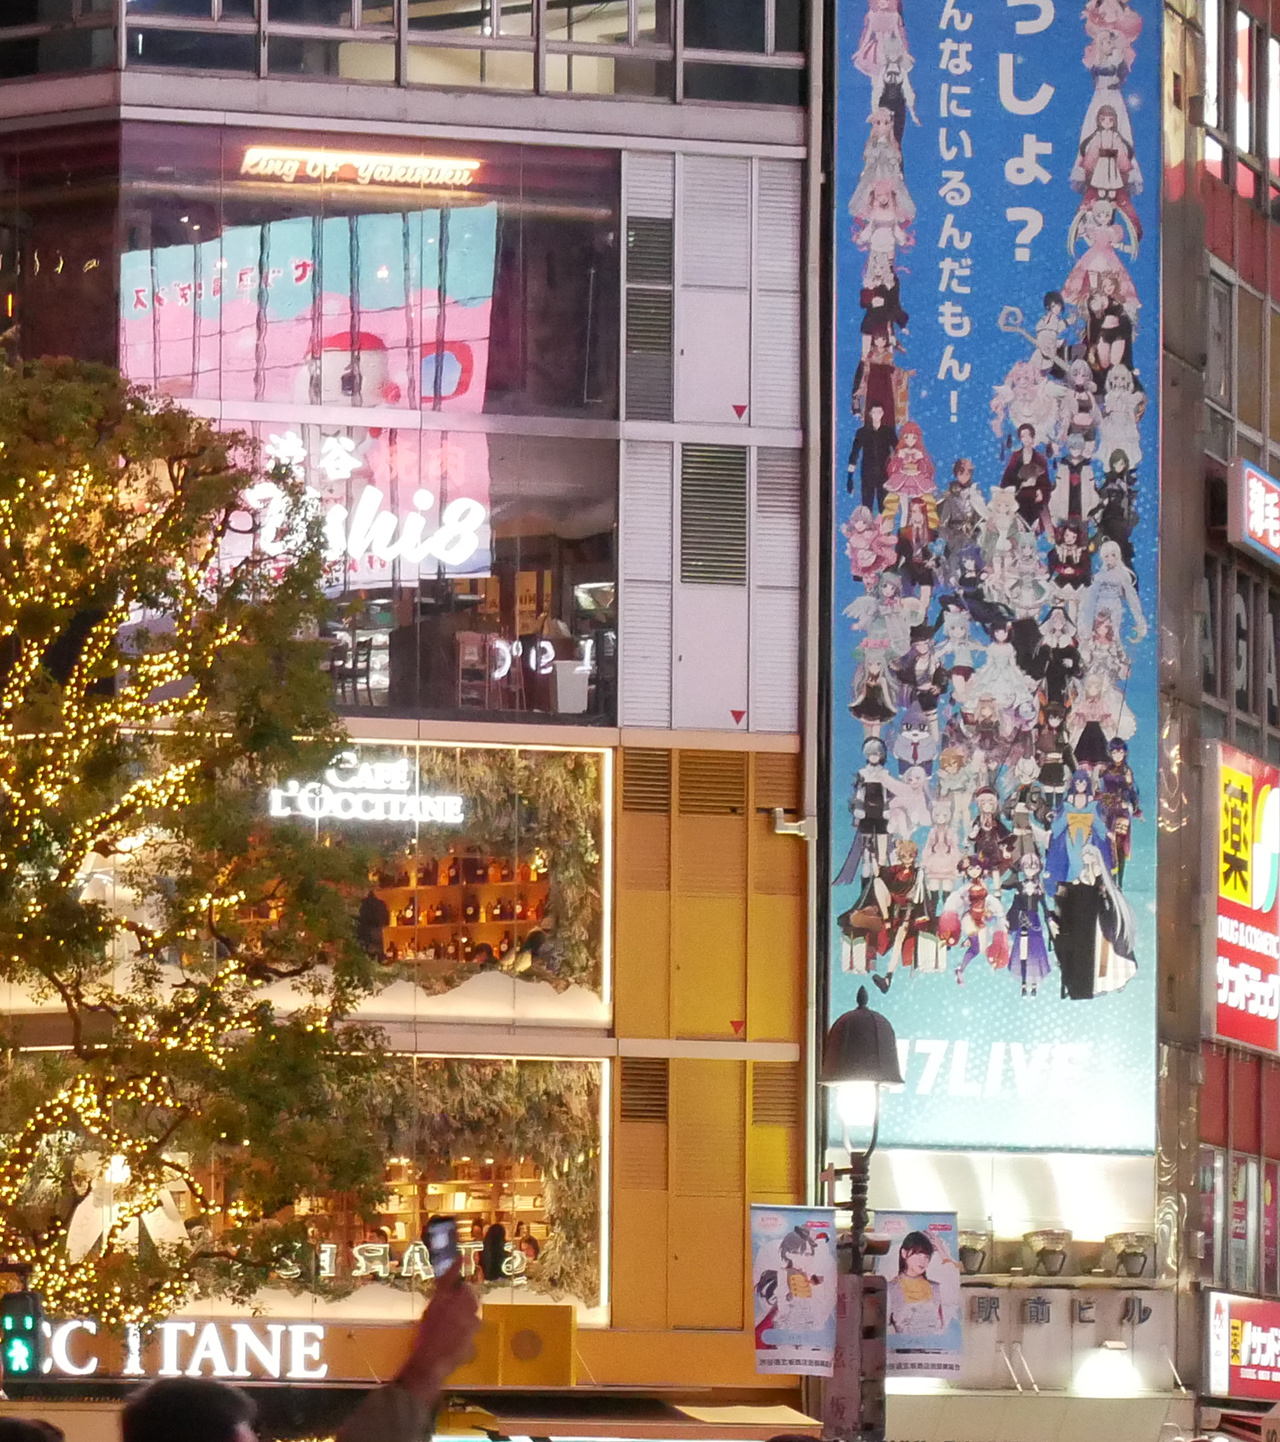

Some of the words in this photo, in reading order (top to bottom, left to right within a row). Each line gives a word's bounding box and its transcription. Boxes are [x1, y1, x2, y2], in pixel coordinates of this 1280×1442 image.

[1223, 779, 1249, 893] 薬
[977, 1297, 1152, 1325] 駅前ビル
